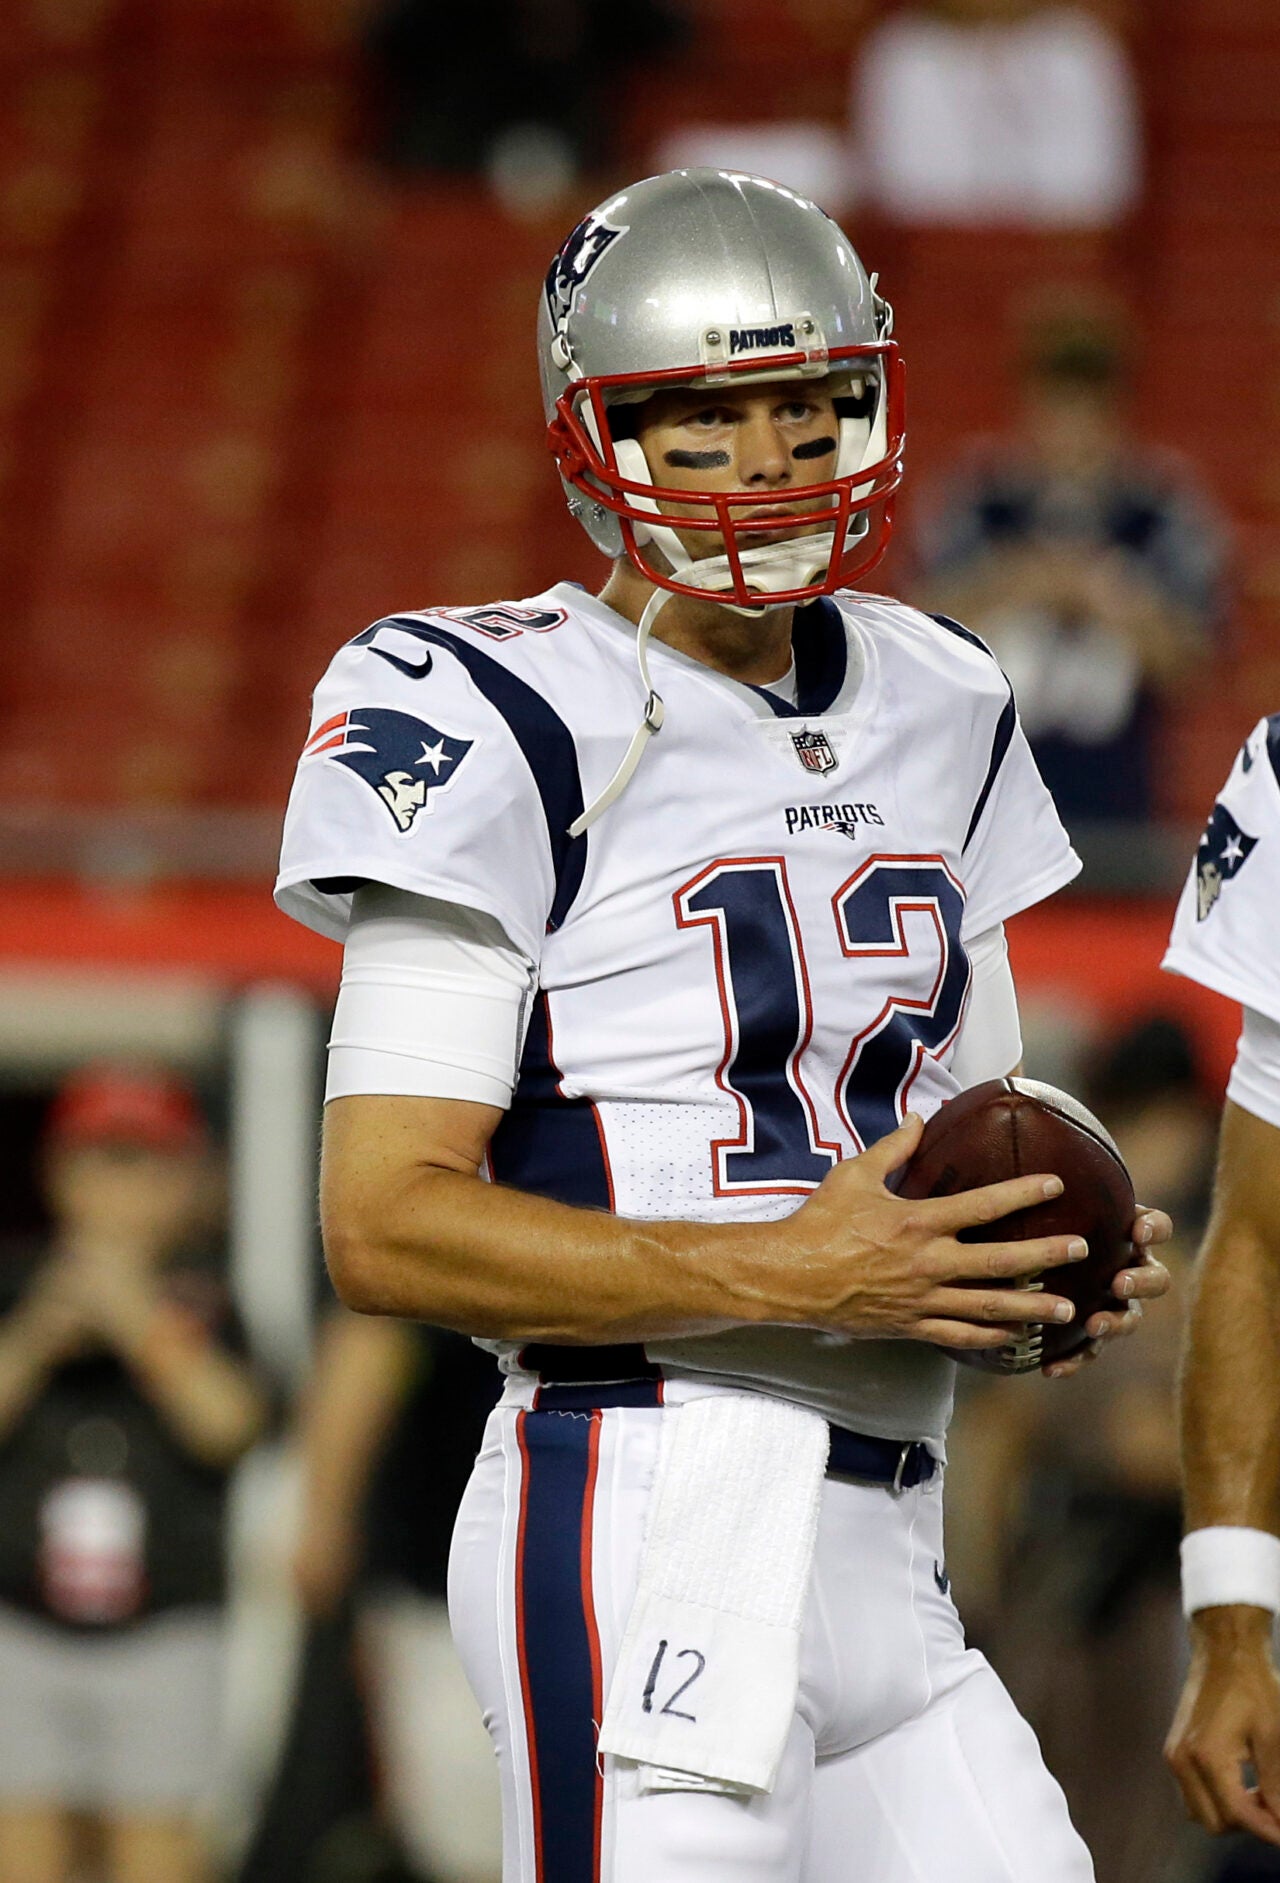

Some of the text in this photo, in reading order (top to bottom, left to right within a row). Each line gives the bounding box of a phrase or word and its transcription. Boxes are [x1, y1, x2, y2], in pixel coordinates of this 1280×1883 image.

[729, 323, 796, 354] PATRIOTS
[800, 747, 832, 769] NFL
[785, 803, 885, 835] PATRIOTS
[672, 853, 973, 1197] 12
[642, 1639, 706, 1723] 12
